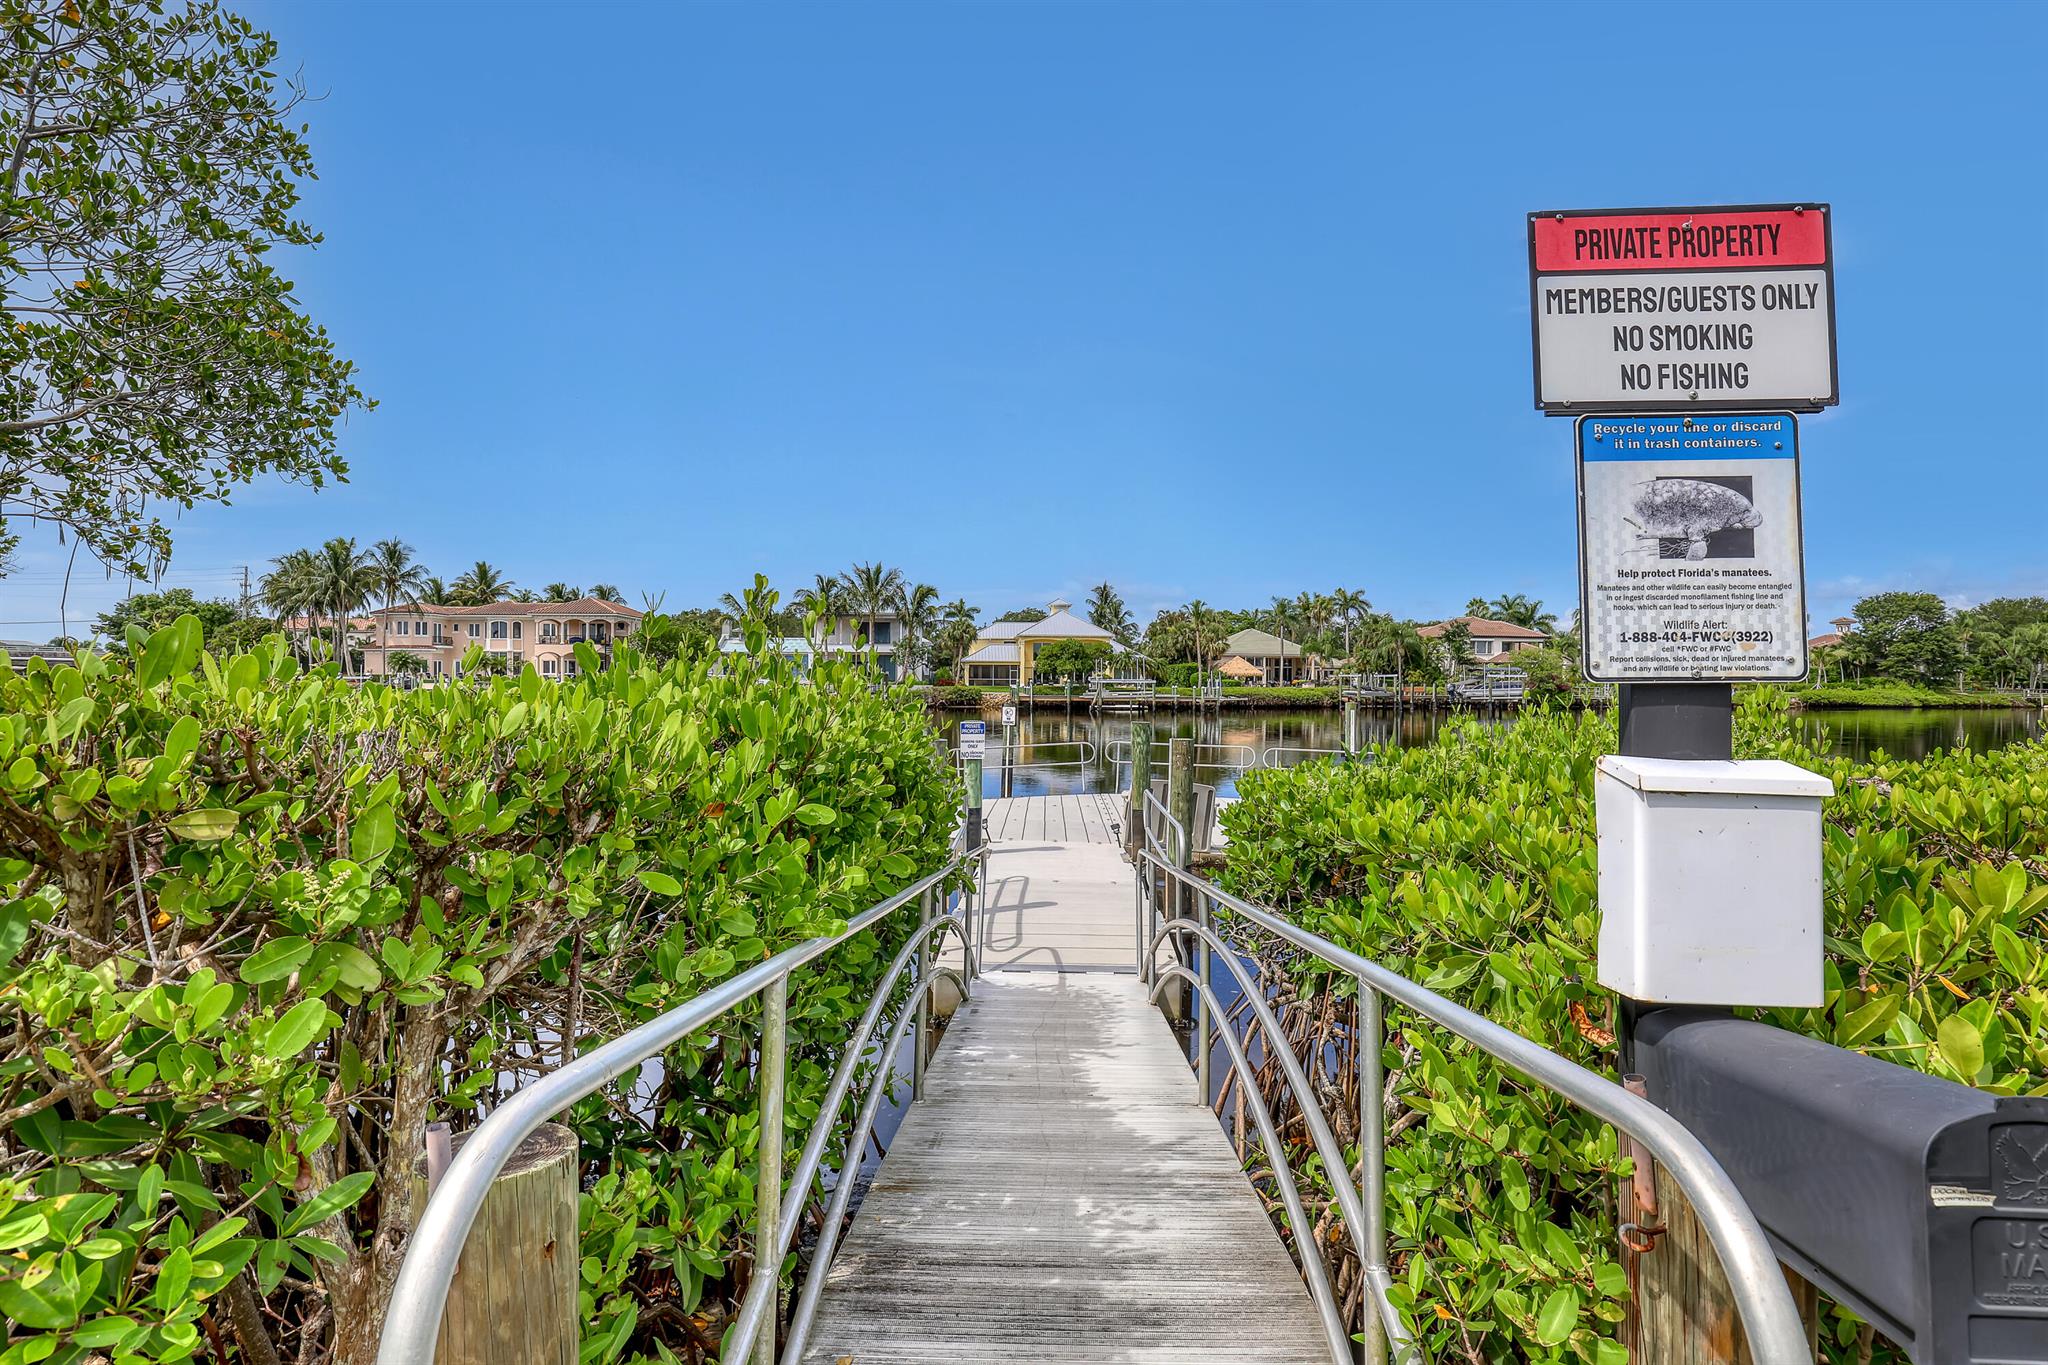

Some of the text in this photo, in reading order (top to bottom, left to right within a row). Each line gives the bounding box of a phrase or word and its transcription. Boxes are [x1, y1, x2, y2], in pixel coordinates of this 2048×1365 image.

[1575, 224, 1781, 260] PRIVATE PROPERTY
[1546, 283, 1819, 315] MEMBERS/GUESTS ONLY
[1613, 323, 1753, 352] NO SMOKING
[1621, 362, 1749, 390] NO FISHING
[1594, 423, 1646, 436] Recycle
[1650, 424, 1679, 435] your
[1713, 423, 1727, 432] or
[1731, 421, 1781, 432] discard
[1614, 437, 1761, 449] it in trash containers.
[1617, 568, 1772, 580] Help protect Florida's manatees.
[1596, 584, 1631, 592] Manatees
[1666, 583, 1691, 591] wildlife
[1707, 583, 1727, 592] easily
[1758, 583, 1793, 591] entangled
[1623, 594, 1645, 602] ingest
[1646, 593, 1680, 601] discarded
[1731, 592, 1755, 601] fishing
[1755, 592, 1769, 600] line
[1770, 592, 1784, 600] and
[1613, 604, 1636, 612] hooks,
[1725, 602, 1745, 611] injury
[1755, 602, 1777, 610] death.
[1663, 620, 1728, 630] Wildlife Alert:
[1609, 655, 1634, 664] Report
[1635, 655, 1671, 663] collisions,
[1672, 655, 1690, 663] sick,
[1721, 654, 1747, 663] injured
[1719, 664, 1733, 672] law
[1734, 664, 1772, 672] violations.
